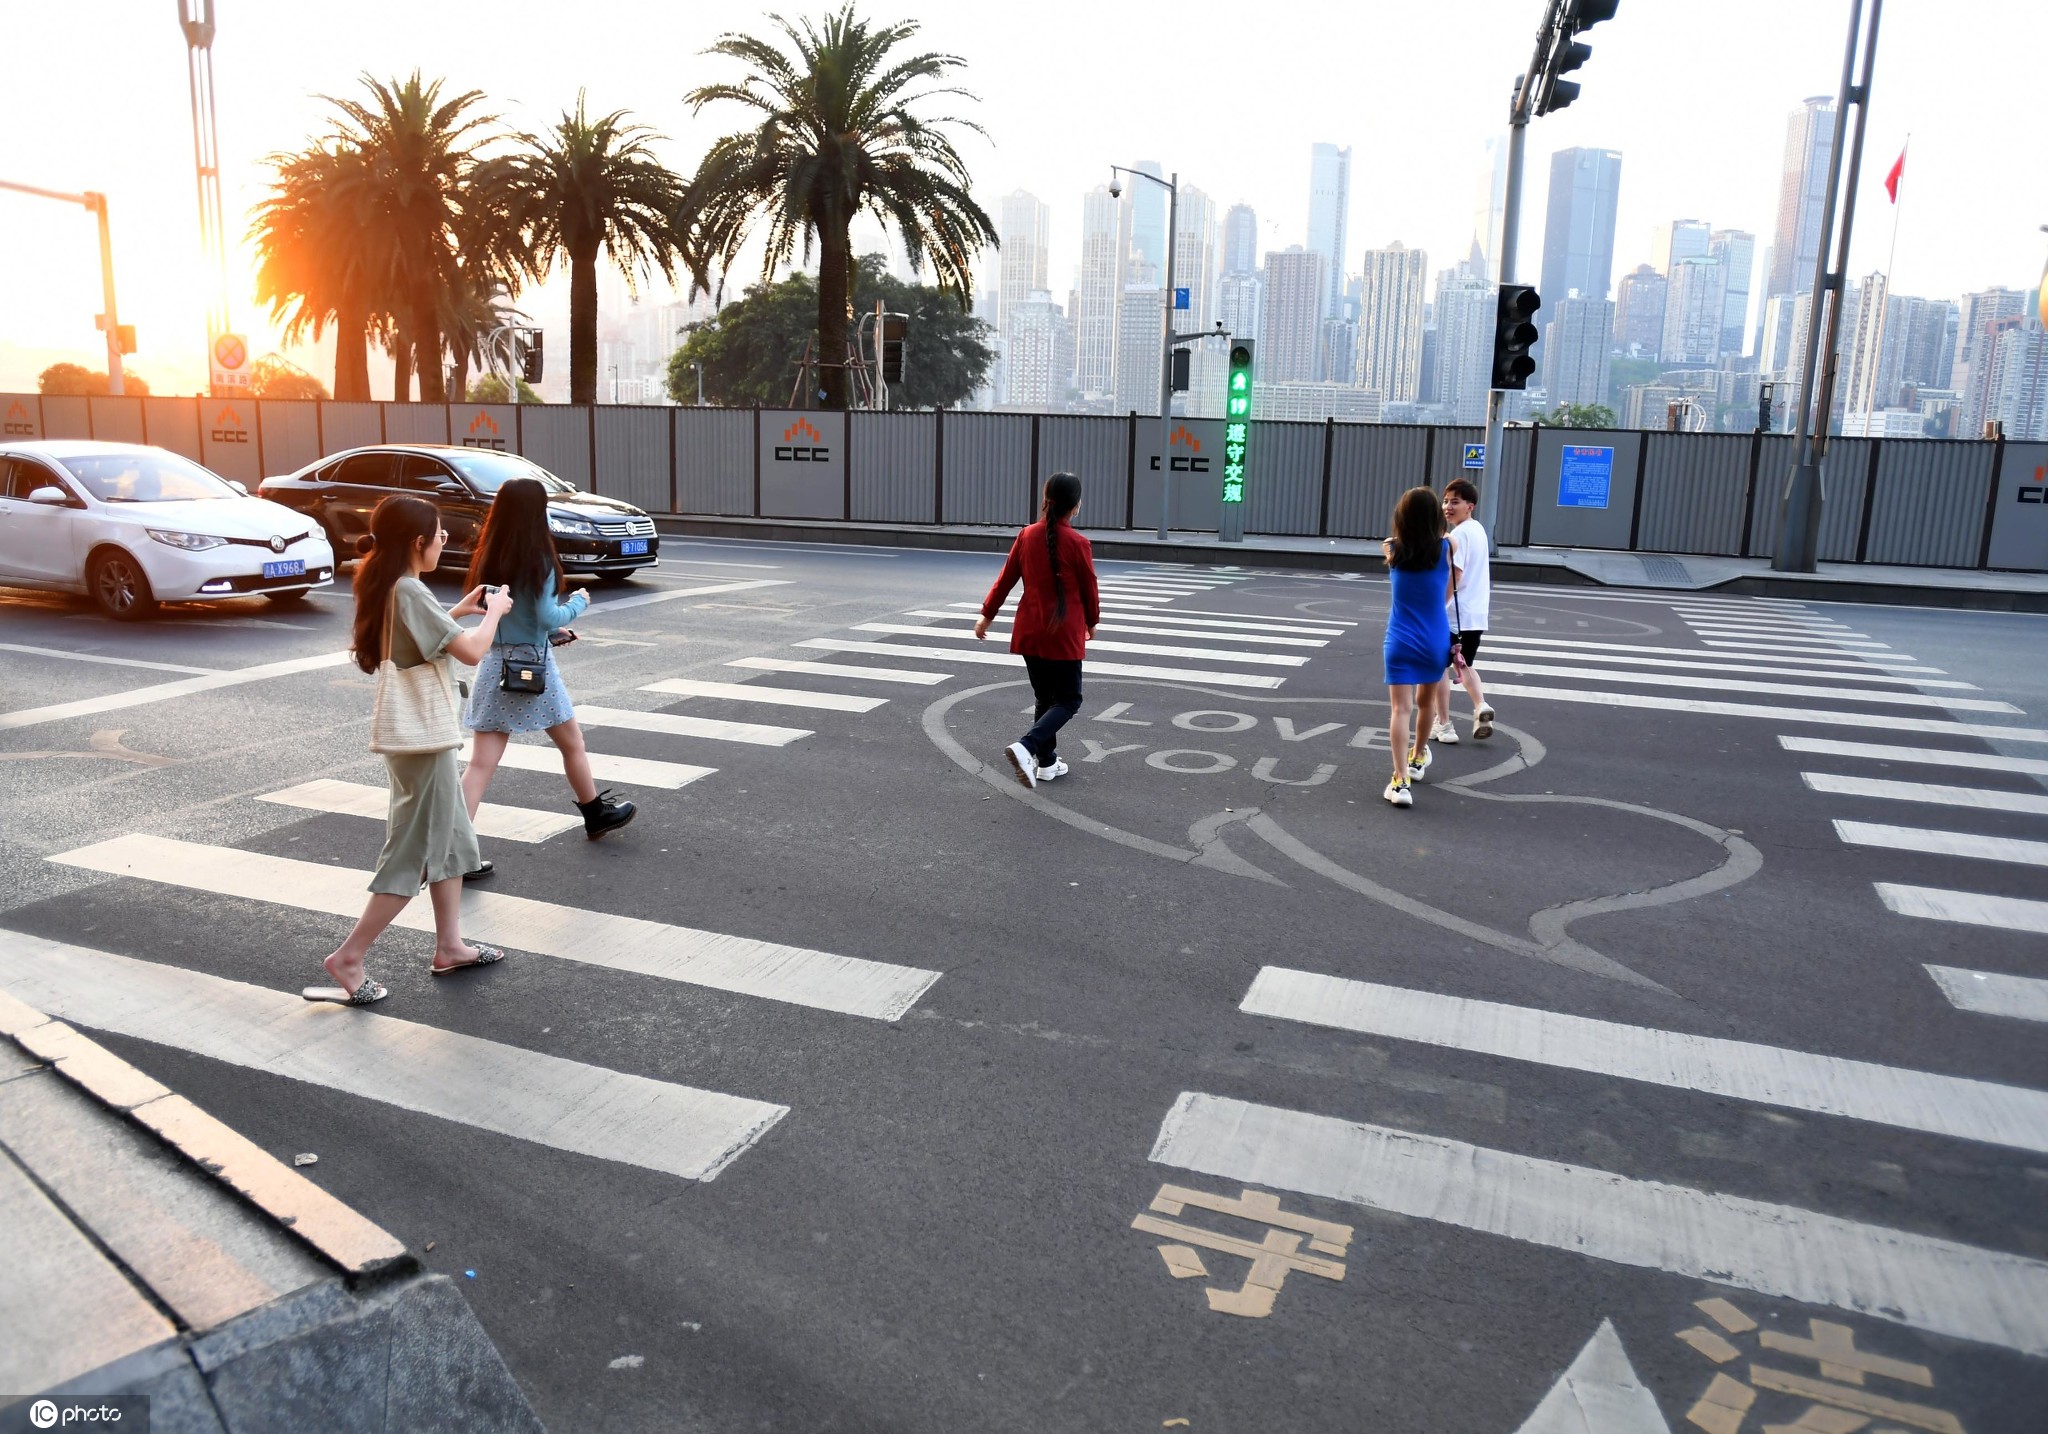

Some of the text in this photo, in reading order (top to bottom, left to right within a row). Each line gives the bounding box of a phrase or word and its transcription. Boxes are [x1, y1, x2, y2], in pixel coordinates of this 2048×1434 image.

[4, 423, 34, 435] CCC
[211, 430, 248, 443] CCC
[775, 446, 829, 462] CCC
[1222, 423, 1247, 503] 遵守交规
[2017, 487, 2048, 503] C
[1092, 702, 1416, 752] LOVE
[1080, 739, 1338, 786] YOU
